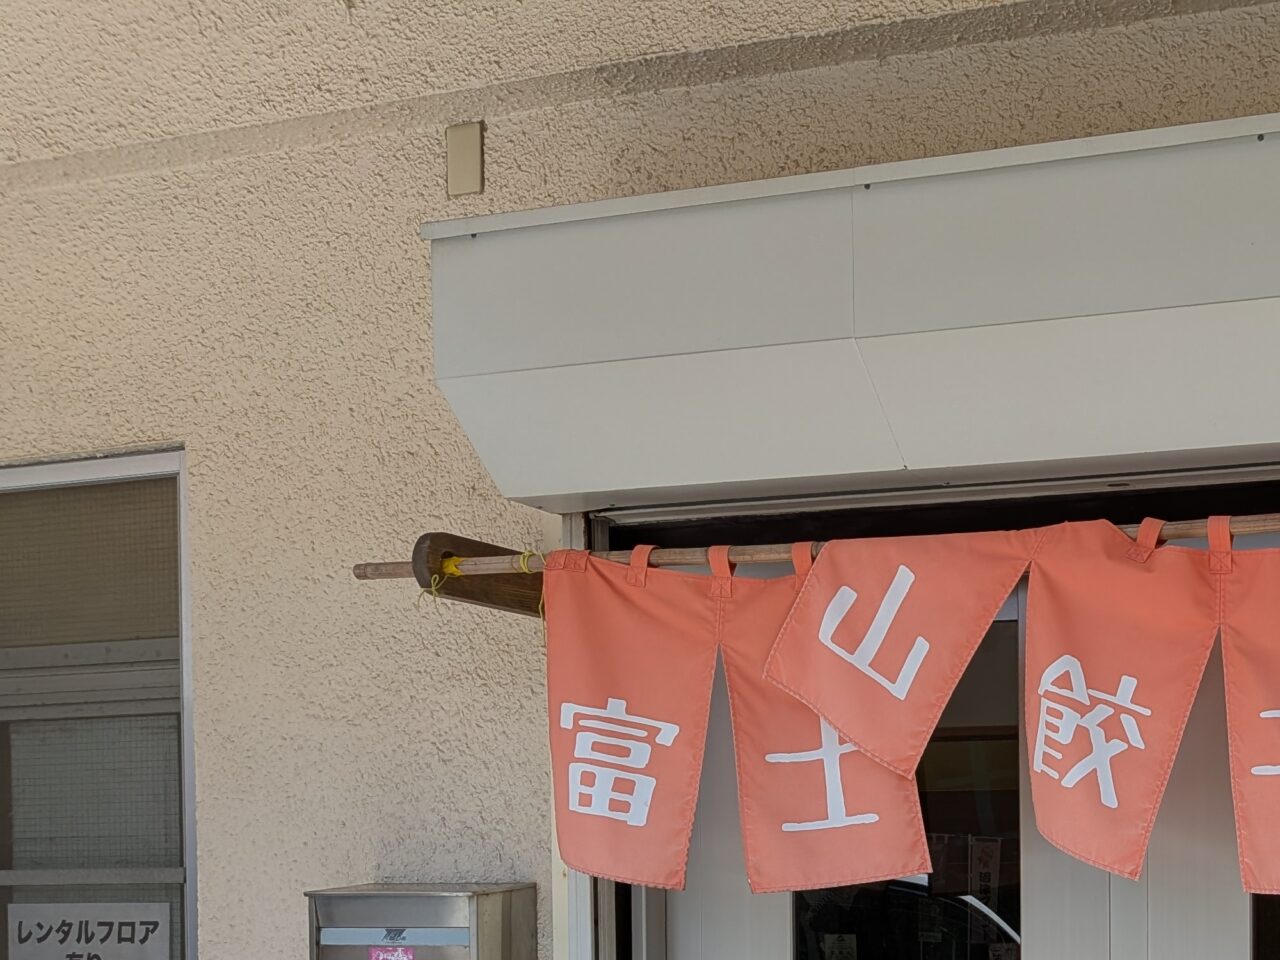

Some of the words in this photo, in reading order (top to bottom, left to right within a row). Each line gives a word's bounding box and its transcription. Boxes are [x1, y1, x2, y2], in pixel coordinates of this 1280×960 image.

[17, 919, 160, 945] レンタルフロア
